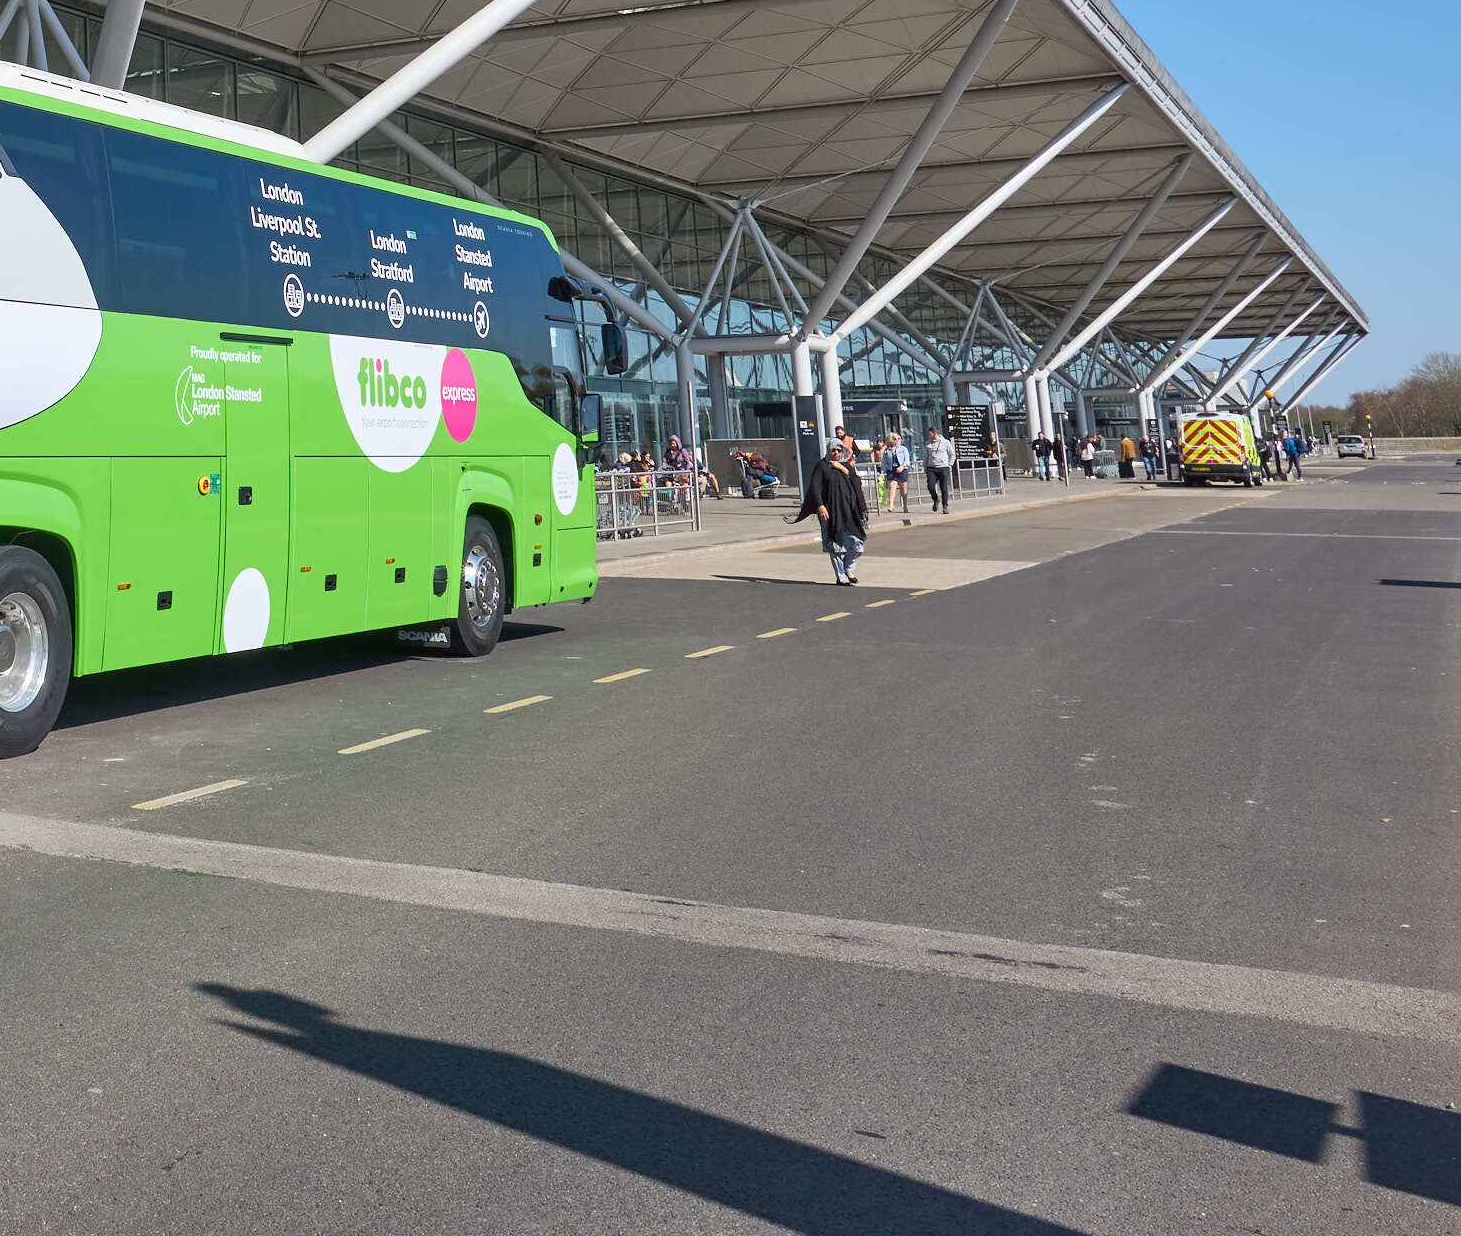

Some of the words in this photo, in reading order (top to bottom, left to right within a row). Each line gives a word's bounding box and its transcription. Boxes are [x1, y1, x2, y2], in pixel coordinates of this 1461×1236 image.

[260, 177, 304, 206] London
[250, 206, 305, 237] Liverpool
[304, 216, 322, 239] St.
[452, 217, 486, 241] London
[269, 240, 312, 267] Station
[369, 229, 407, 254] London
[455, 243, 493, 268] Stansted
[370, 257, 414, 284] Stratford
[463, 271, 494, 295] Airport
[190, 345, 219, 364] Proudly
[220, 351, 250, 364] operated
[251, 352, 262, 364] for
[192, 383, 224, 400] London
[225, 385, 262, 403] Stansted
[357, 357, 427, 409] flibco
[442, 386, 476, 405] express
[192, 399, 221, 419] Airport
[397, 630, 448, 643] SCANIA
